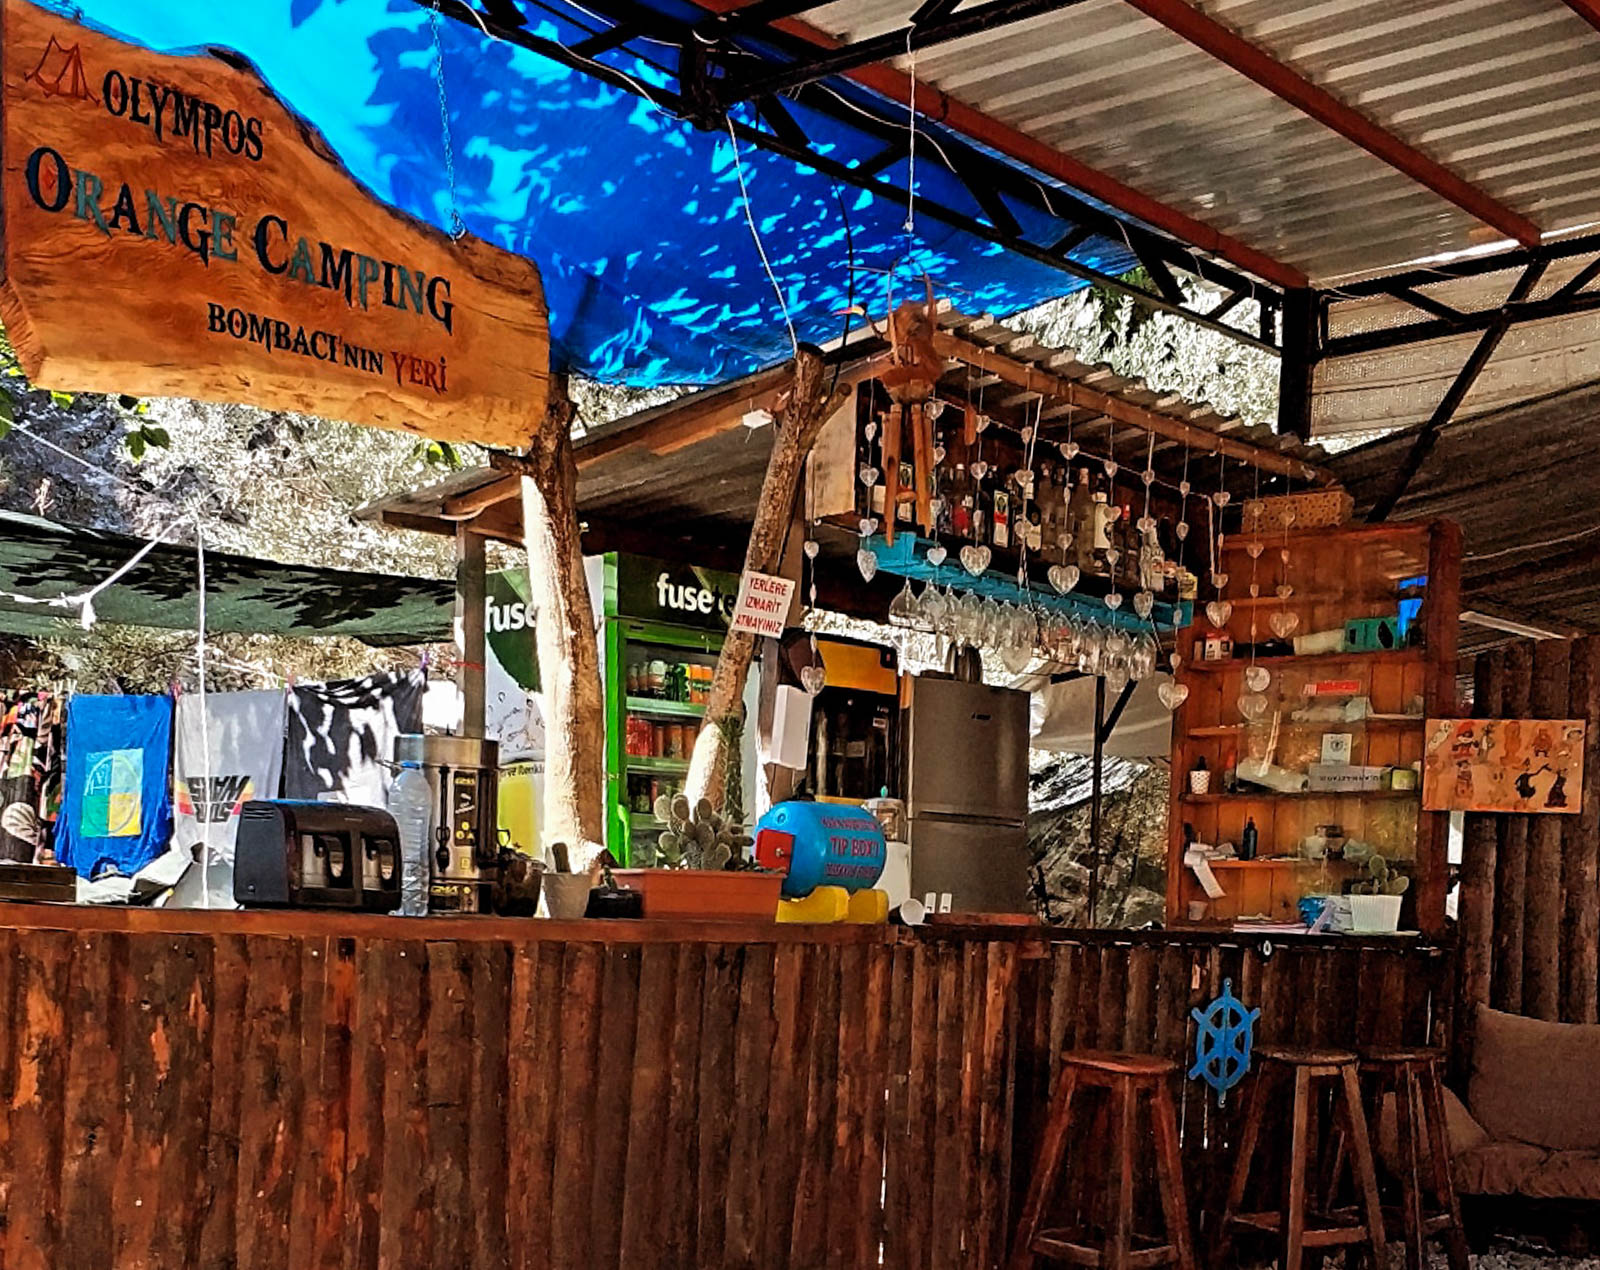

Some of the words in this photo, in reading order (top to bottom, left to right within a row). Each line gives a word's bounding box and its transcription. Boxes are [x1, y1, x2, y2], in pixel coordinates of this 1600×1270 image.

[103, 69, 263, 162] OLYMPOS
[24, 147, 238, 268] ORANGE
[252, 215, 455, 336] CAMPING
[749, 577, 788, 597] YERLERE
[830, 836, 849, 857] TIP
